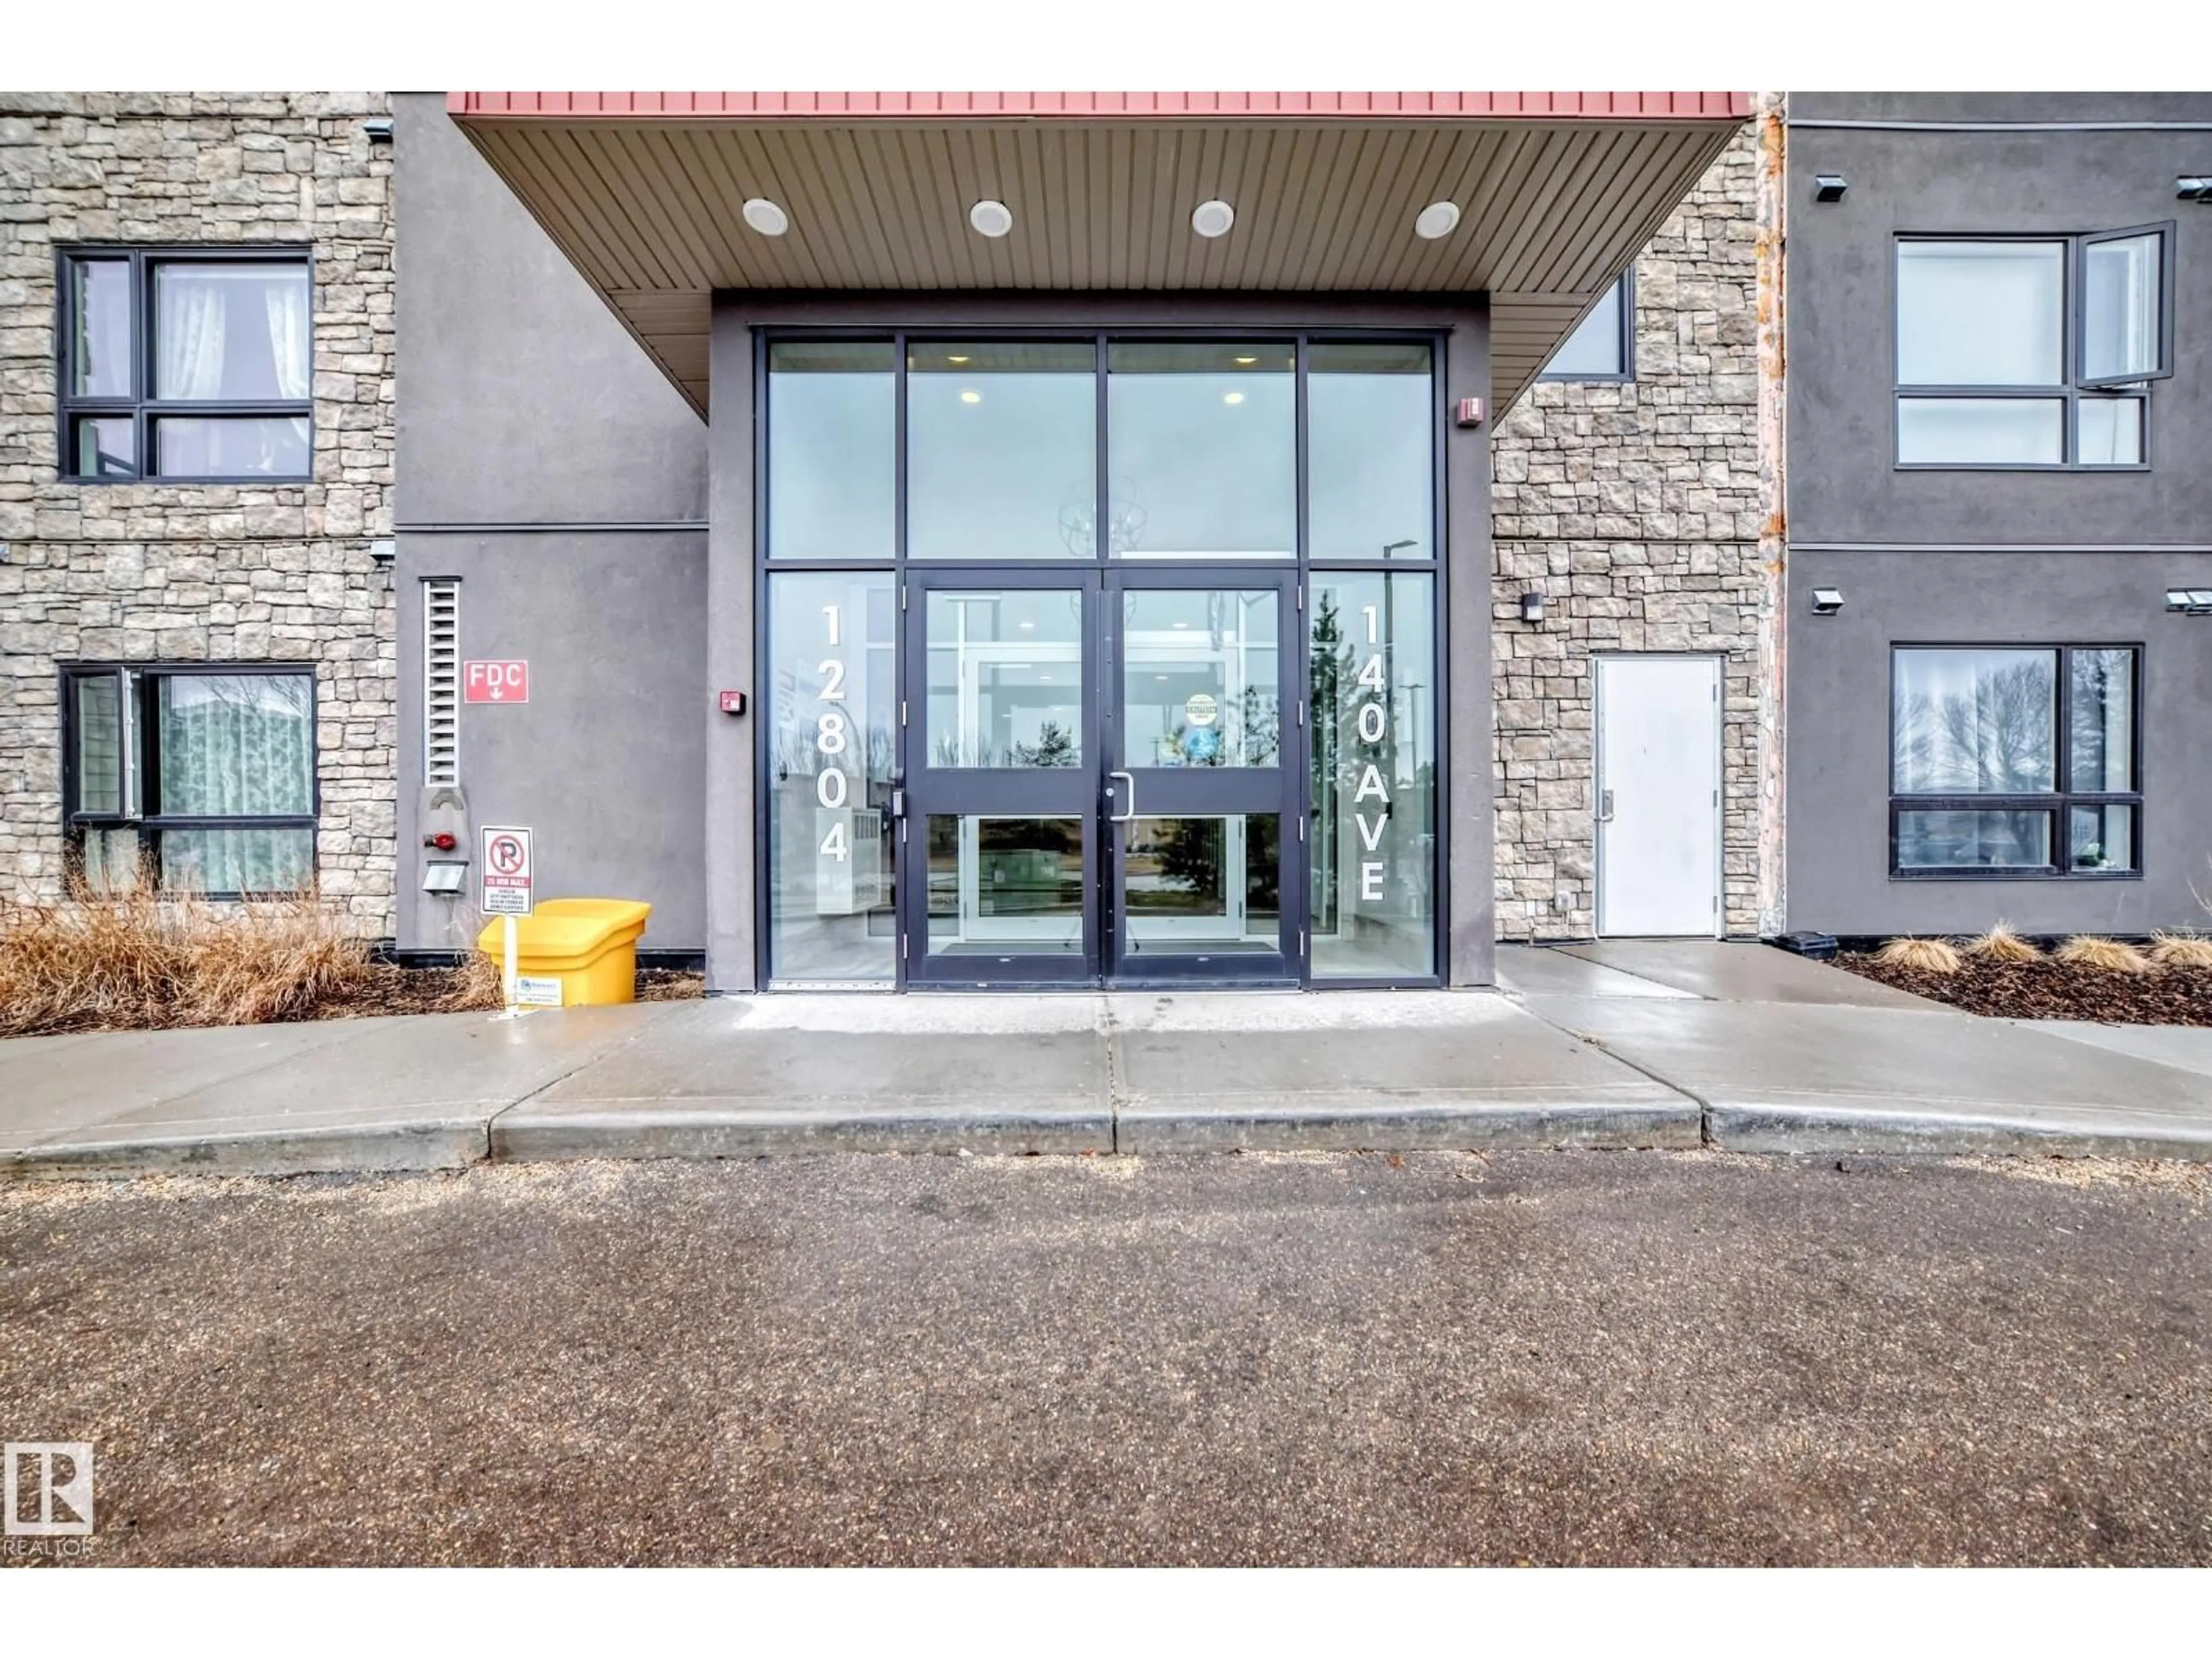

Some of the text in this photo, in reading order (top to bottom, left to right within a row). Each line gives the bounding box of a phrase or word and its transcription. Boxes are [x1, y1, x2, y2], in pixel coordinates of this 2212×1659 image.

[470, 663, 521, 687] FDC
[816, 605, 847, 863] 12804
[1354, 605, 1390, 900] 140 AVE
